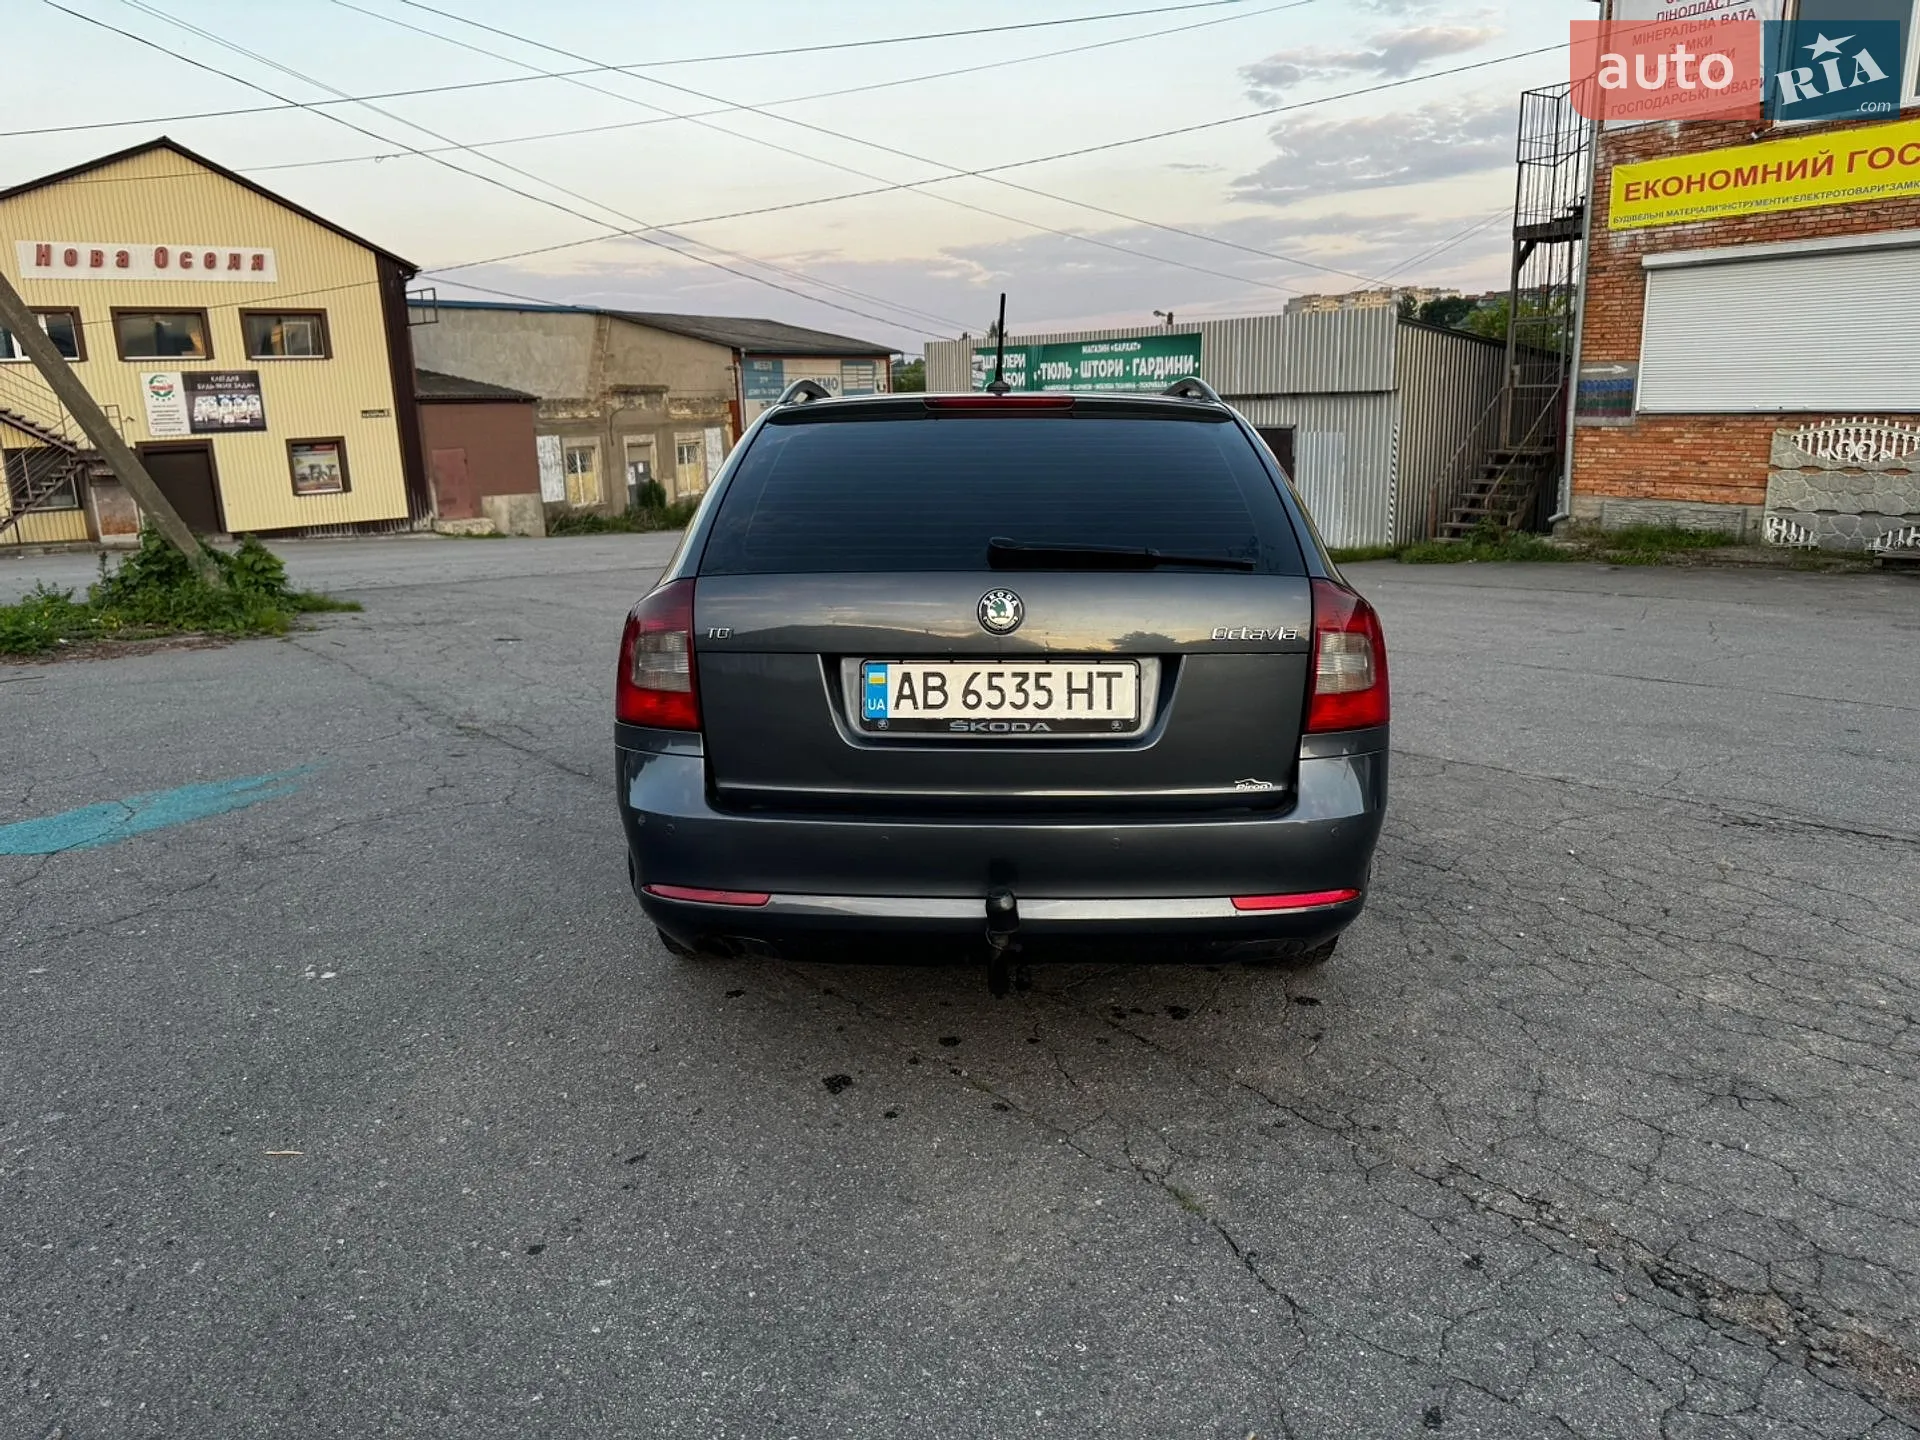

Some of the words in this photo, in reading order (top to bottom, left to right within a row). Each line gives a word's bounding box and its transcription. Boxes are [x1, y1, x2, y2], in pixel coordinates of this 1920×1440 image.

[1631, 17, 1716, 46] МІНЕРАЛЬНА
[1720, 9, 1756, 27] ВАТА
[1611, 87, 1710, 116] ГОСПОДАРСЬКІ
[1623, 149, 1834, 202] ЕКОНОМНИЙ
[35, 243, 130, 269] Нова
[154, 246, 265, 272] Оселя
[982, 353, 1026, 370] ШПЛЕРИ
[1040, 362, 1073, 380] ТЮЛЬ
[1080, 359, 1124, 379] ШТОРИ
[1132, 354, 1194, 379] ГАРДИНИ
[1212, 626, 1298, 641] Octavia
[867, 699, 886, 711] UA
[893, 671, 949, 710] AB
[961, 671, 1054, 711] 6535
[1066, 671, 1123, 711] HT
